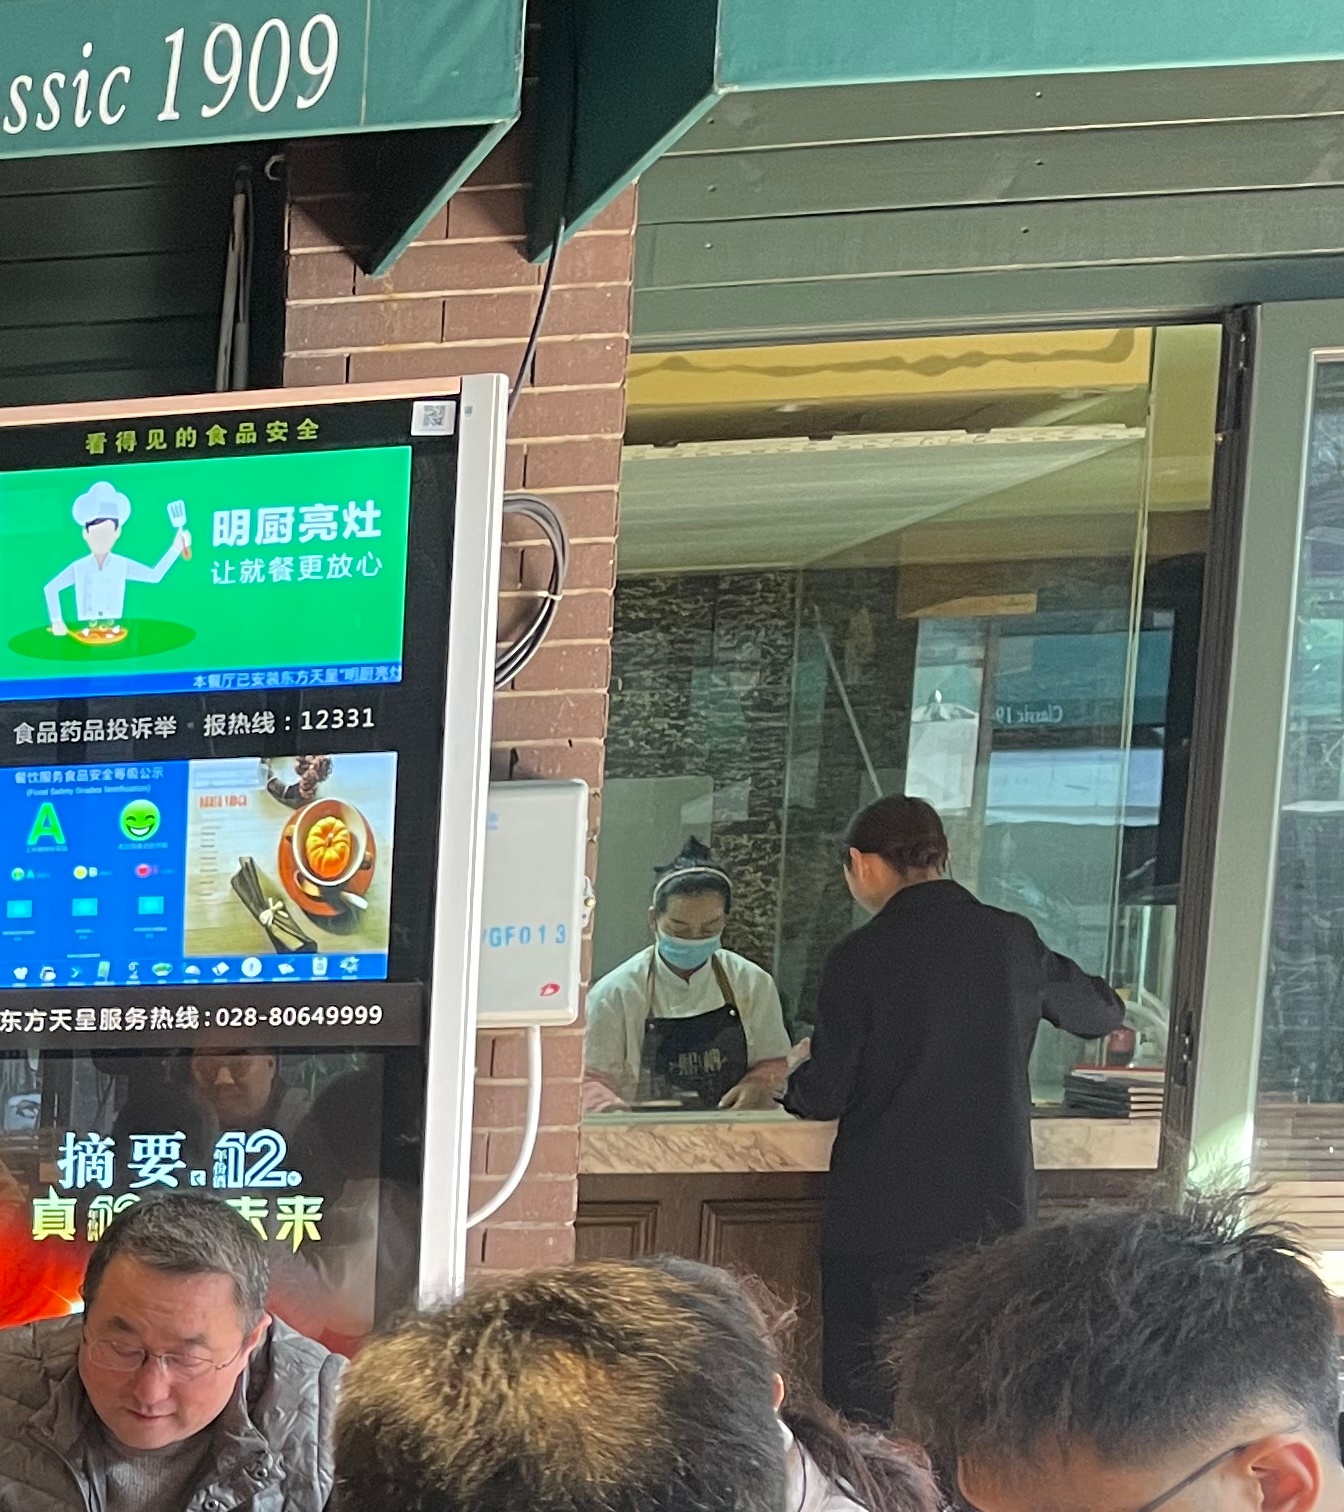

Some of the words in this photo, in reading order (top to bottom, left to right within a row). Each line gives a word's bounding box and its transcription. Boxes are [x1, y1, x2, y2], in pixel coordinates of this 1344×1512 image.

[157, 12, 340, 123] 1909
[85, 417, 319, 455] 看得见的食品安全
[212, 499, 382, 547] 明厨亮灶
[211, 551, 383, 585] 让就餐更放心
[27, 802, 66, 845] A
[481, 923, 566, 948] GF013
[57, 1131, 186, 1189] 摘要
